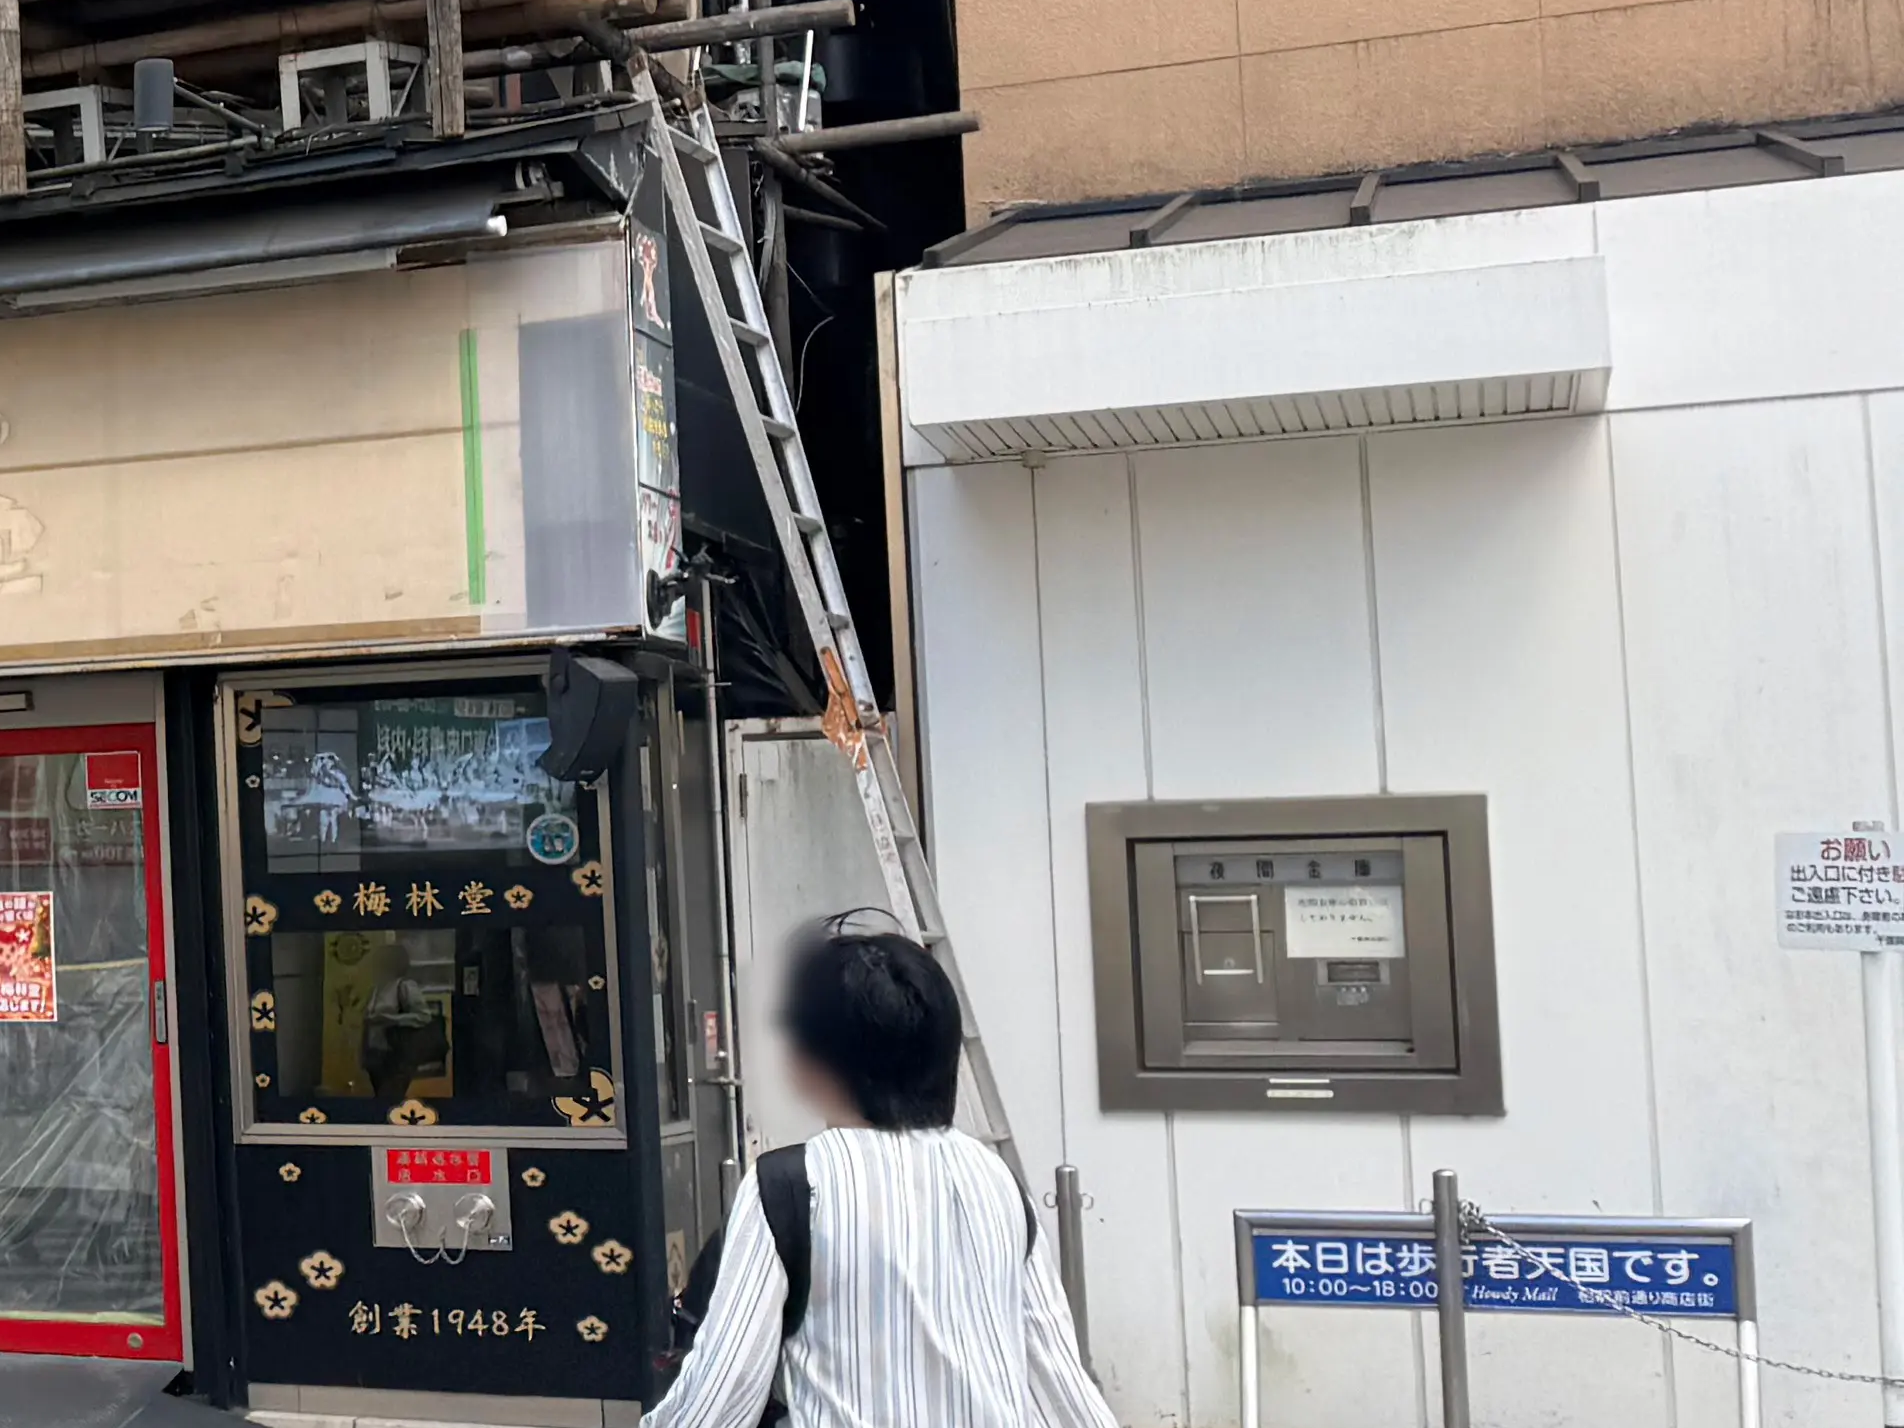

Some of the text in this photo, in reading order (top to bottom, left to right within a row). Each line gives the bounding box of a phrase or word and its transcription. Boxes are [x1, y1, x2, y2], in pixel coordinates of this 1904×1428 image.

[90, 789, 138, 804] SECOM
[1820, 838, 1891, 862] お願い
[354, 881, 493, 917] 梅林堂
[1473, 1284, 1520, 1303] Howdy
[349, 1300, 546, 1342] 創業1948年
